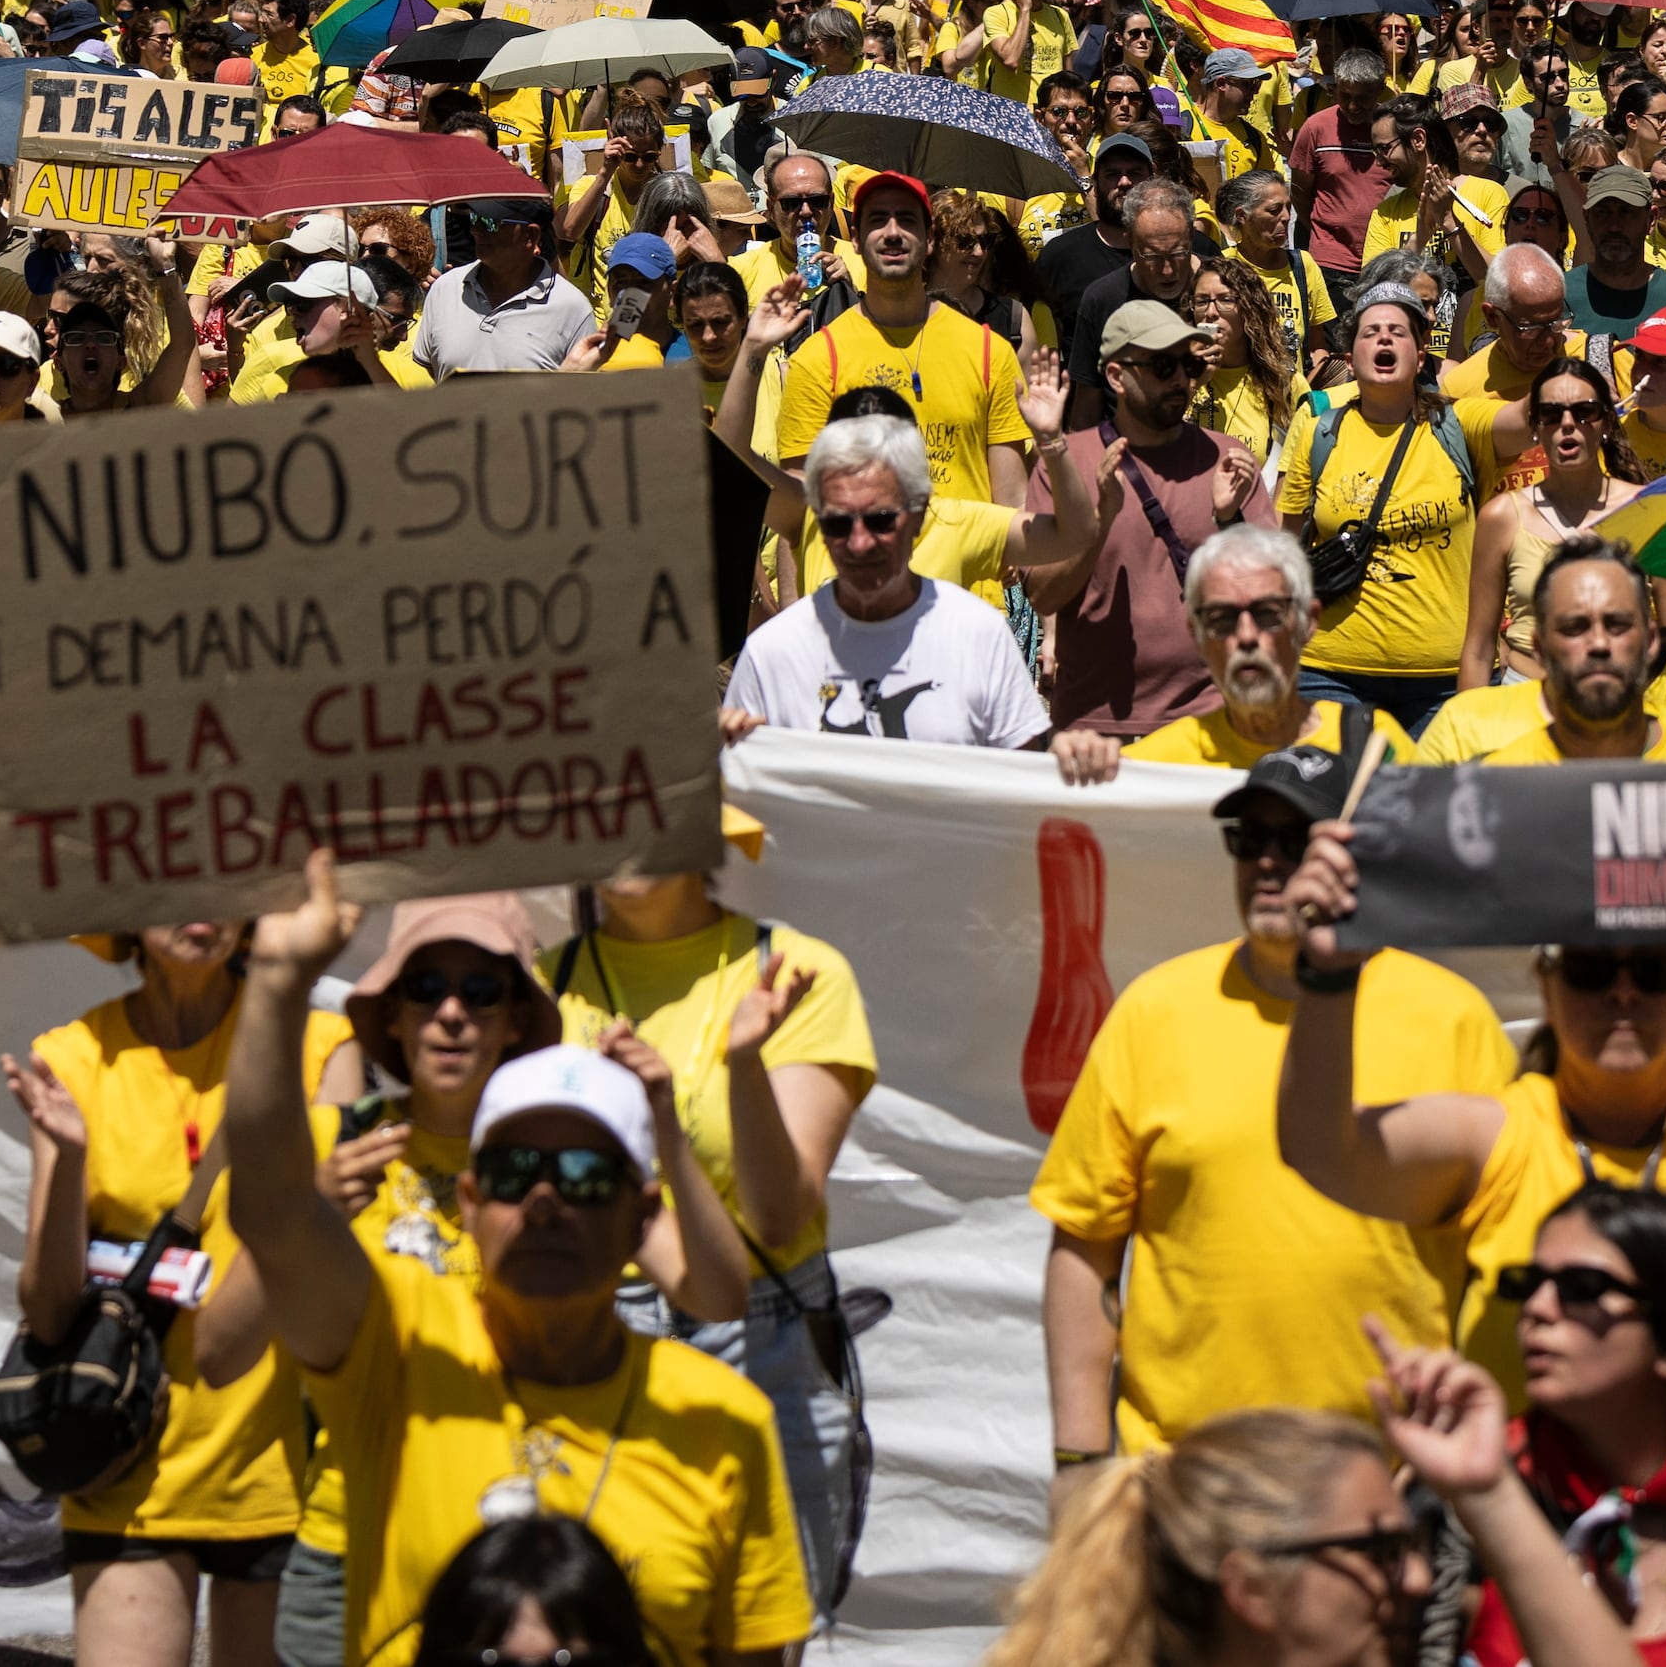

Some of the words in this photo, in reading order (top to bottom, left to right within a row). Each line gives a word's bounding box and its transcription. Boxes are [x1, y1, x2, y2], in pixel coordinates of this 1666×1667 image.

[501, 2, 530, 24] NO
[268, 70, 294, 83] SOS
[1569, 75, 1598, 88] SOS
[395, 401, 659, 538] SURT
[46, 596, 342, 691] DEMANA
[383, 544, 594, 665] PERDÓ
[639, 569, 692, 649] A
[128, 702, 240, 778] LA
[303, 667, 593, 759] CLASSE
[15, 747, 666, 891] TREBALLADORA
